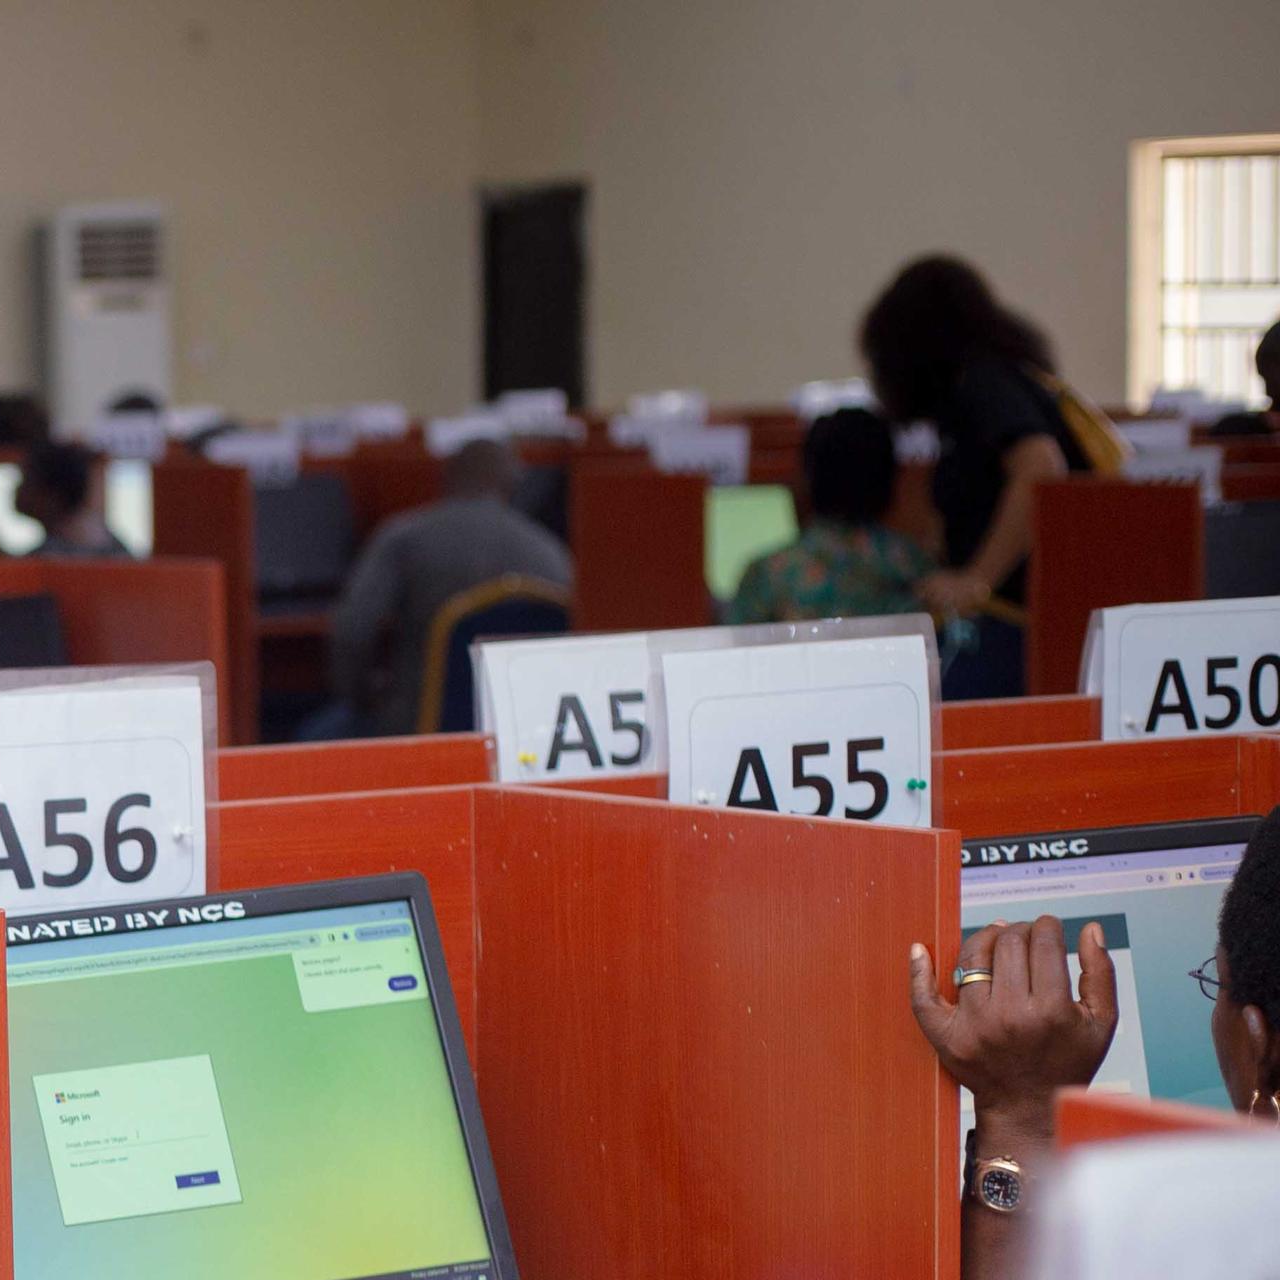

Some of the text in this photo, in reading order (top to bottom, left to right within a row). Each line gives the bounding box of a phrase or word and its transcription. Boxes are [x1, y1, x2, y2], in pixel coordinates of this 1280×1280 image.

[1145, 653, 1280, 733] A50
[546, 690, 651, 771] A5
[726, 737, 889, 821] A55
[980, 844, 1020, 863] BY
[1029, 838, 1089, 860] NCC
[8, 901, 246, 942] NATED BY NCC
[67, 1089, 100, 1101] Microsoft
[59, 1112, 91, 1126] Sign in
